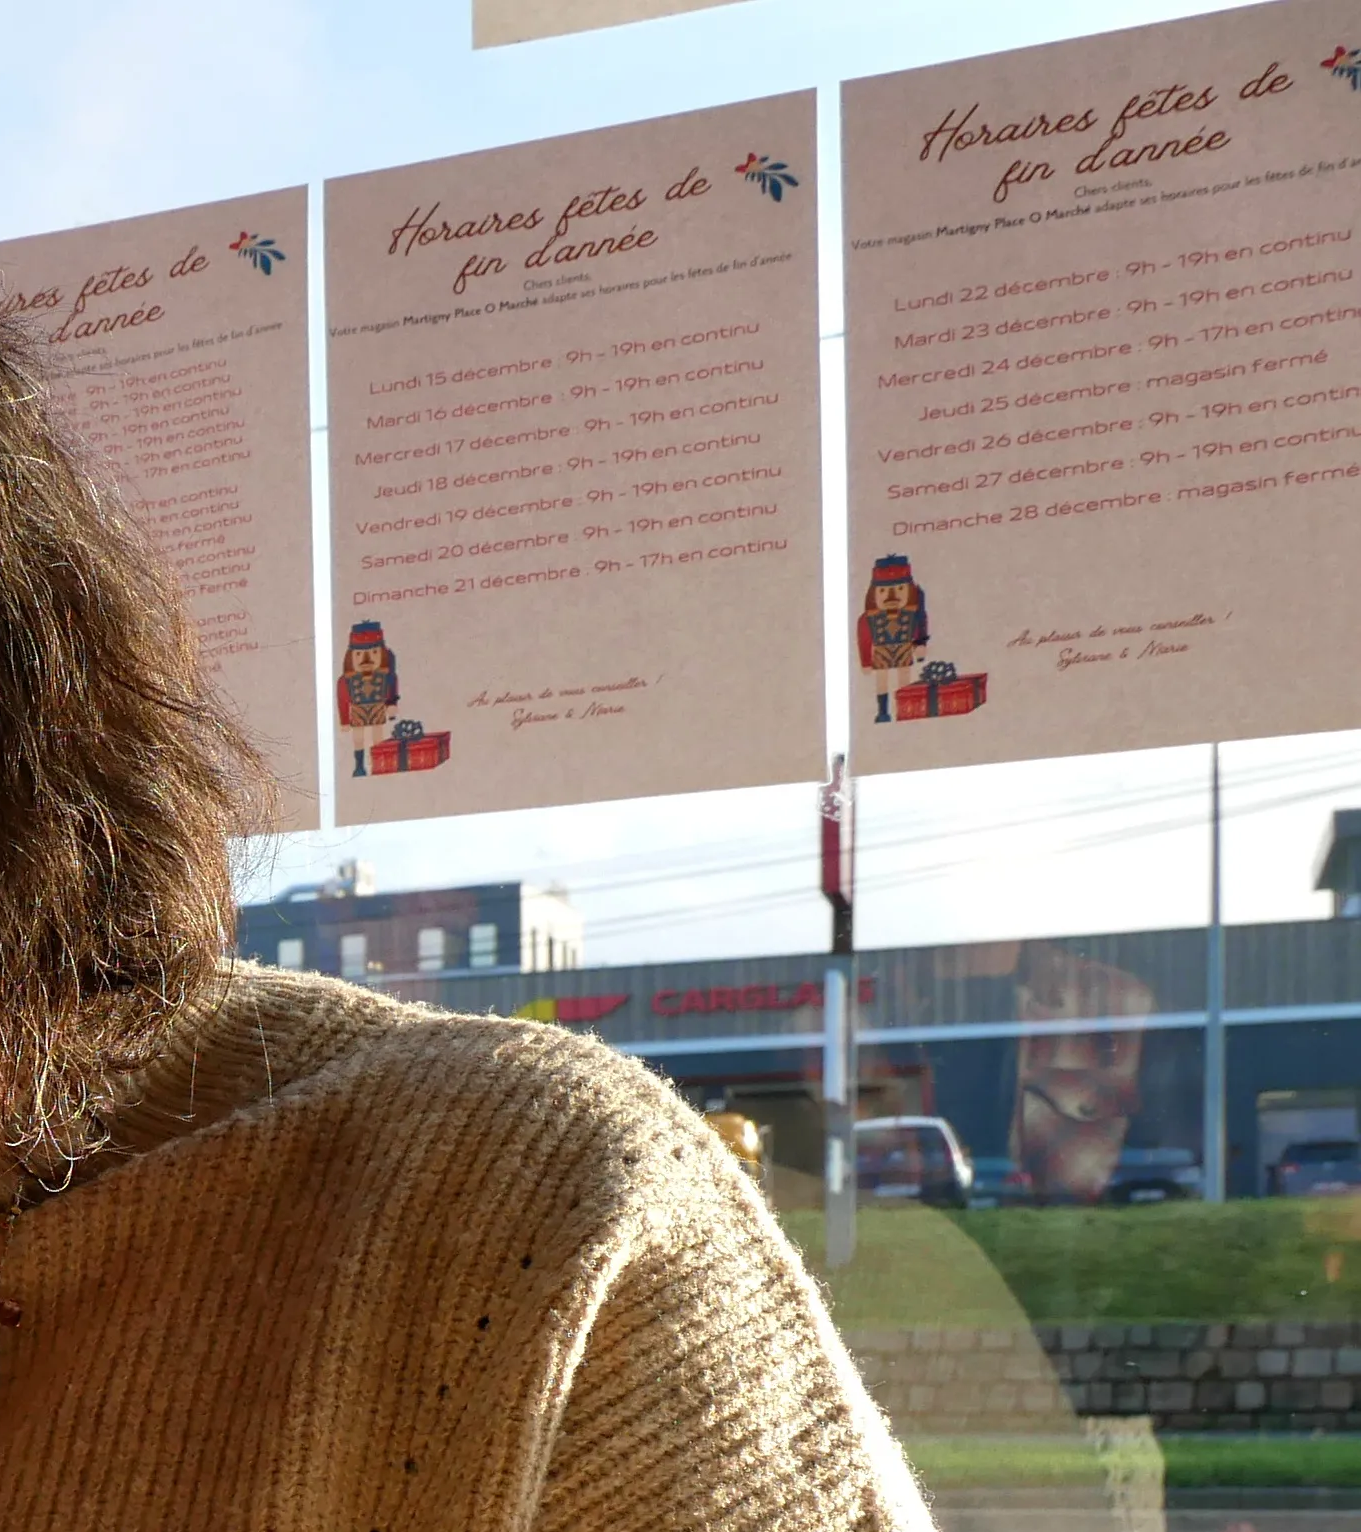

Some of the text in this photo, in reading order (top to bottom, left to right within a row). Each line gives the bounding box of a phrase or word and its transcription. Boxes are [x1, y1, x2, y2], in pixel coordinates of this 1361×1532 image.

[920, 61, 1294, 163] Horaires fêtes de
[388, 202, 543, 256] Horaires
[665, 167, 712, 202] de
[993, 159, 1054, 203] fin
[936, 223, 991, 237] Martigny
[994, 217, 1025, 229] Place
[74, 264, 153, 313] fêtes
[170, 245, 210, 278] de
[453, 252, 507, 294] fin
[895, 229, 1352, 312] Lundi 22 décembre 9h 19h en continu
[403, 313, 451, 326] Martigny
[454, 308, 481, 318] Place
[895, 270, 1352, 349] Mardi 23 décembre 9h 19h en continu
[370, 323, 759, 395] Lundi 15 décembre 9h 19h en continu
[878, 364, 975, 389] Mercredi
[982, 358, 1010, 375] 24
[1016, 344, 1132, 370] décembre
[1148, 334, 1178, 350] 9h
[1199, 325, 1239, 341] 17h
[1245, 321, 1273, 335] en
[919, 349, 1328, 421] Jeudi 25 décembre magasin fermé
[187, 419, 245, 438] continu
[367, 360, 764, 429] Mardi 16 décembre 9h 19h en continu
[878, 387, 1361, 463] Vendredi 26 décembre 9h 19h en contin
[192, 450, 251, 469] continu
[355, 393, 778, 465] Mercredi 17 décembre 9h 19h en continu
[374, 434, 760, 499] Jeudi 18 décembre 9h 19h en continu
[888, 477, 968, 499] Samedi
[975, 472, 1003, 488] 27
[1008, 459, 1124, 484] décembre
[1140, 451, 1170, 466] 9h
[1192, 442, 1233, 459] 19h
[1239, 439, 1267, 452] en
[893, 462, 1361, 536] Dimanche 28 décembre magasin fermé
[356, 467, 781, 535] Vendredi 19 décembre 9h 19h en continu
[361, 504, 777, 569] Samedi 20 décembre 9h 19h en continu
[353, 539, 787, 606] Dimanche 21 décembre 9h 17h en continu
[650, 975, 877, 1018] CARGLAS
